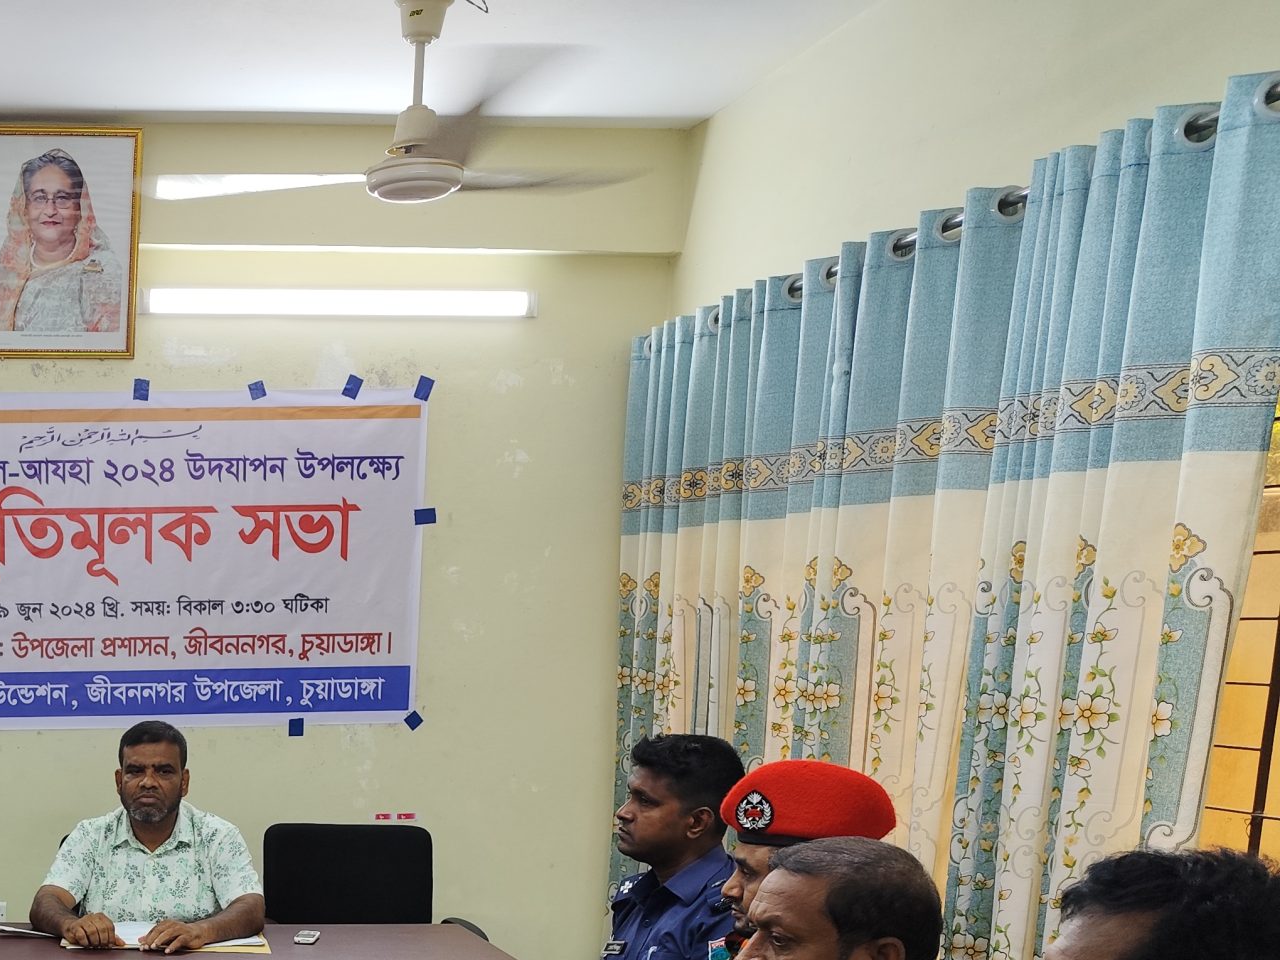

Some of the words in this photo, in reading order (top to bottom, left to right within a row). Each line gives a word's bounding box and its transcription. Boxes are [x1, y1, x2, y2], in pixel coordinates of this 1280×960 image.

[103, 457, 175, 487] ২০২৪
[183, 449, 289, 483] উদযাপন
[294, 447, 405, 481] উপলক্ষ্যে
[232, 497, 361, 562] সভা
[15, 602, 44, 623] জুন
[49, 601, 96, 620] ২০২৪
[100, 596, 125, 620] খ্রি.
[129, 600, 171, 617] সময়:
[175, 594, 226, 616] বিকাল
[230, 600, 276, 615] ৩:৩০
[281, 592, 331, 614] ঘটিকা
[11, 631, 96, 660] উপজেলা
[100, 636, 177, 660] প্রশাসন,
[182, 626, 294, 658] জীবননগর,
[84, 674, 188, 705] জীবননগর
[299, 676, 386, 708] চুয়াডাঙ্গা
